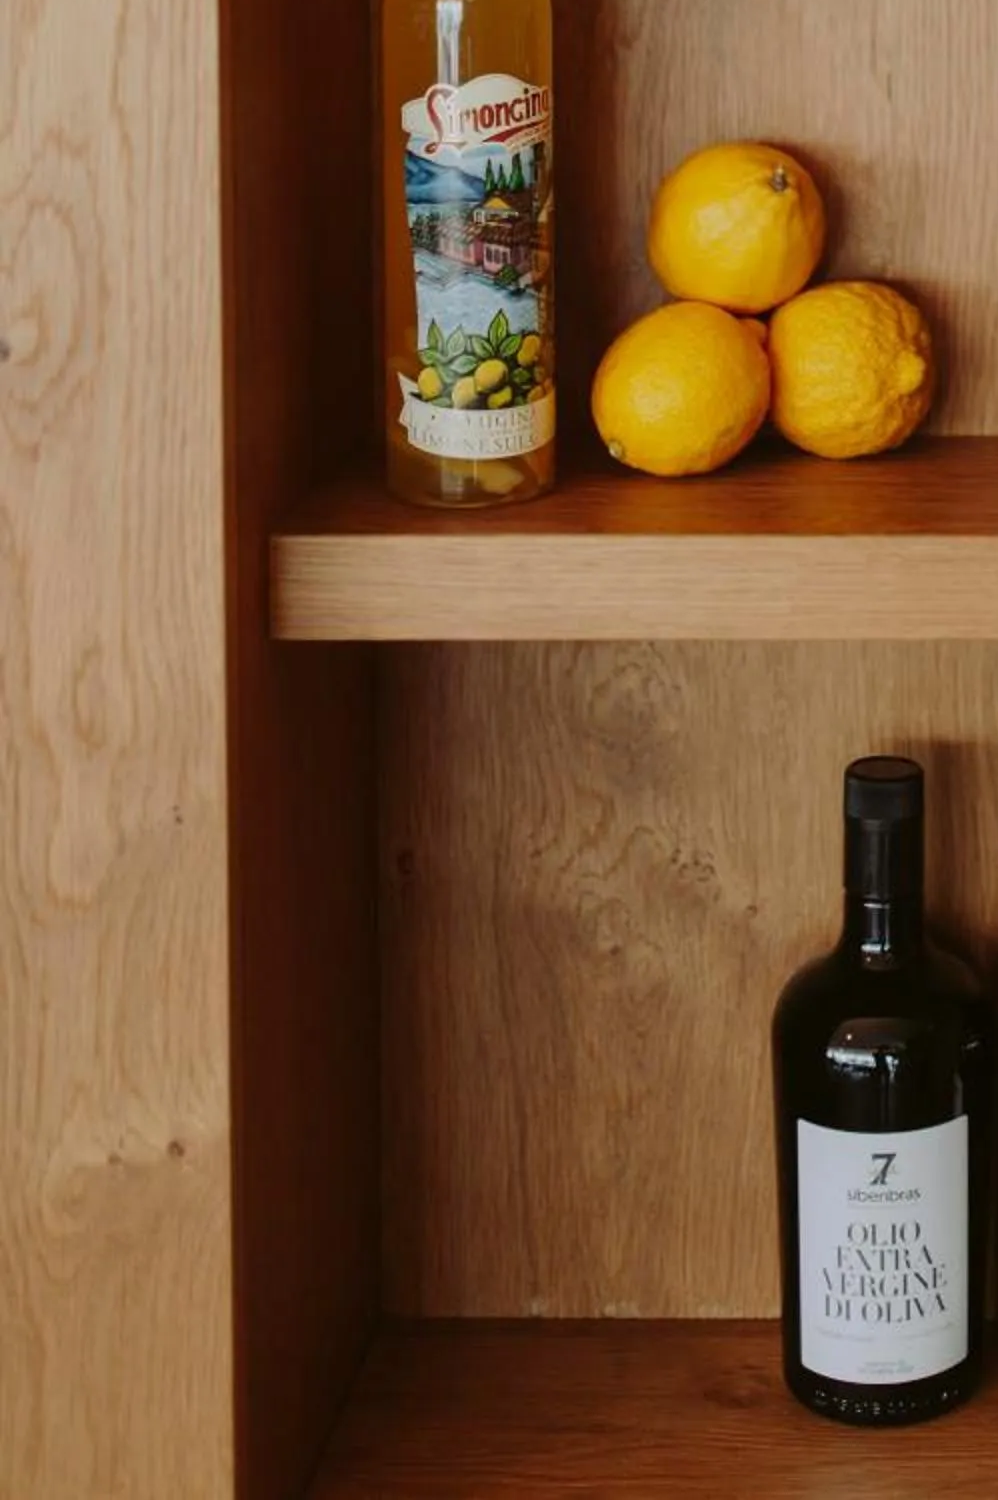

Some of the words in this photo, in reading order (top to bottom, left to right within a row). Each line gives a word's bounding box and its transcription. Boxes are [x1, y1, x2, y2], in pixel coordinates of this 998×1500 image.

[848, 1188, 921, 1202] sibenbras
[847, 1220, 921, 1246] OLIO
[836, 1245, 933, 1272] EXTRA
[823, 1264, 948, 1297] VERGINE
[861, 1293, 946, 1324] OLIVA
